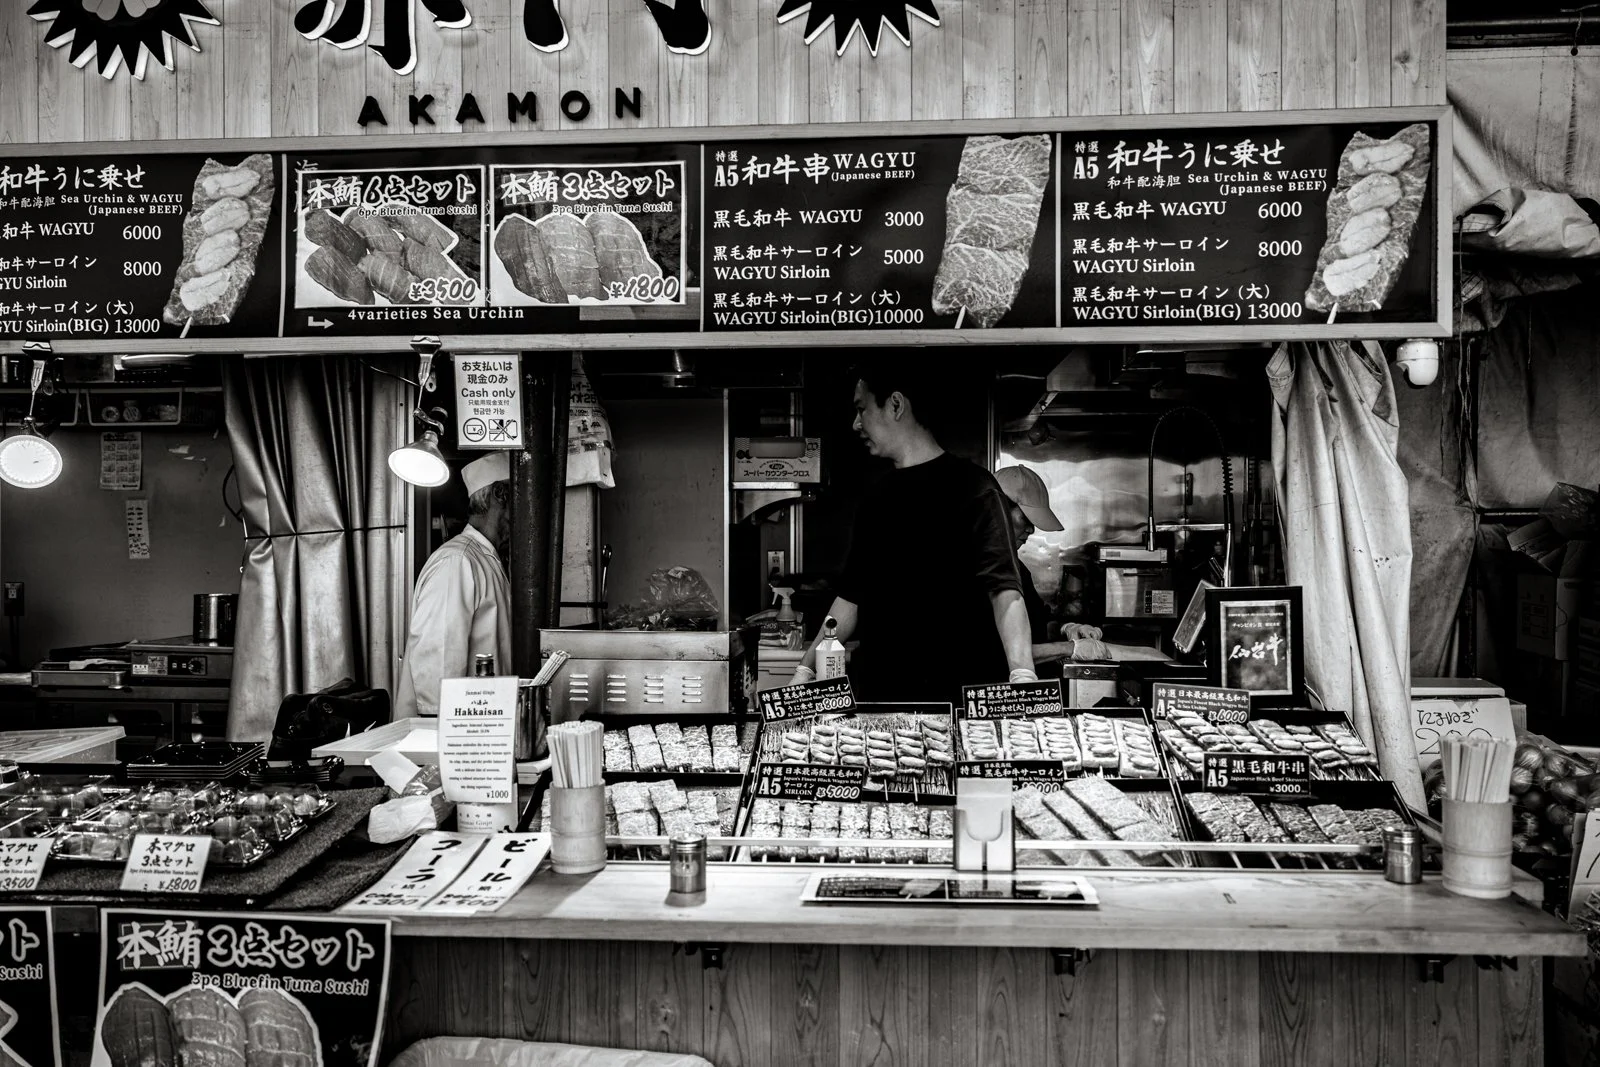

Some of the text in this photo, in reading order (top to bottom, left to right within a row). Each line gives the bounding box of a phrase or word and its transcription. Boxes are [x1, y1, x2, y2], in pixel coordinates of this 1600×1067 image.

[357, 87, 642, 126] AKAMON
[1074, 141, 1099, 153] 特選
[715, 150, 739, 162] 特選
[1107, 138, 1285, 174] 和牛うに乗せ
[714, 164, 739, 187] A5
[741, 152, 916, 185] 和牛串 WAGYU
[831, 170, 915, 181] (Japanese BEEF)
[1073, 156, 1099, 180] A5
[1188, 168, 1327, 184] Sea Urchin & WAGYU
[0, 164, 146, 195] 和牛うに乗せ
[1219, 181, 1327, 196] (Japanese BEEF)
[61, 194, 183, 203] Sea Urchin & WAGYU
[89, 205, 183, 216] (Japanese BEEF)
[358, 208, 377, 219] 6pc
[380, 207, 417, 217] Bluefin
[420, 206, 445, 216] Tuna
[447, 204, 477, 215] Sushi
[553, 202, 672, 215] 3pc Bluefin Tuna Sushi
[1072, 200, 1302, 221] 黒毛和牛 WAGYU 6000
[713, 208, 924, 228] 黒毛和牛 WAGYU 3000
[0, 221, 161, 240] 和牛 WAGYU 6000
[713, 244, 924, 265] 黒毛和牛サーロイン 5000
[1072, 236, 1302, 257] 黒毛和牛サーロイン 8000
[123, 261, 162, 276] 8000
[713, 265, 830, 280] WAGYU Sirloin
[1073, 258, 1195, 274] WAGYU Sirloin
[25, 276, 67, 289] Sirloin
[410, 277, 477, 301] ¥3500
[611, 276, 679, 299] ¥1800
[348, 306, 524, 321] 4varieties Sea Urchin
[713, 311, 776, 325] WAGYU
[1073, 302, 1302, 321] WAGYU Sirloin(BIG) 13000
[26, 318, 109, 334] Sirloin(BIG)
[115, 319, 160, 333] 13000
[462, 361, 513, 372] お支払いは
[467, 374, 509, 385] 現金のみ
[461, 387, 516, 399] Cash only
[454, 707, 503, 717] Hakkaisan
[764, 701, 786, 720] A5
[815, 696, 852, 712] ¥8000
[968, 700, 988, 718] A5
[1209, 709, 1247, 723] ¥6000
[785, 767, 862, 779] 日本最高級黒毛和牛
[1208, 758, 1305, 775] 特選 黒毛和牛串
[758, 777, 781, 795] A5
[1207, 769, 1228, 787] A5
[487, 791, 509, 799] ¥1000
[816, 785, 860, 799] ¥5000
[1269, 784, 1300, 793] ¥3000
[145, 837, 196, 854] 本マグロ
[406, 839, 462, 883] コーラ
[480, 838, 538, 882] ビール
[0, 876, 35, 890] 3500
[0, 918, 40, 961] ト
[191, 972, 370, 996] 3pc Bluefin Tuna Sushi
